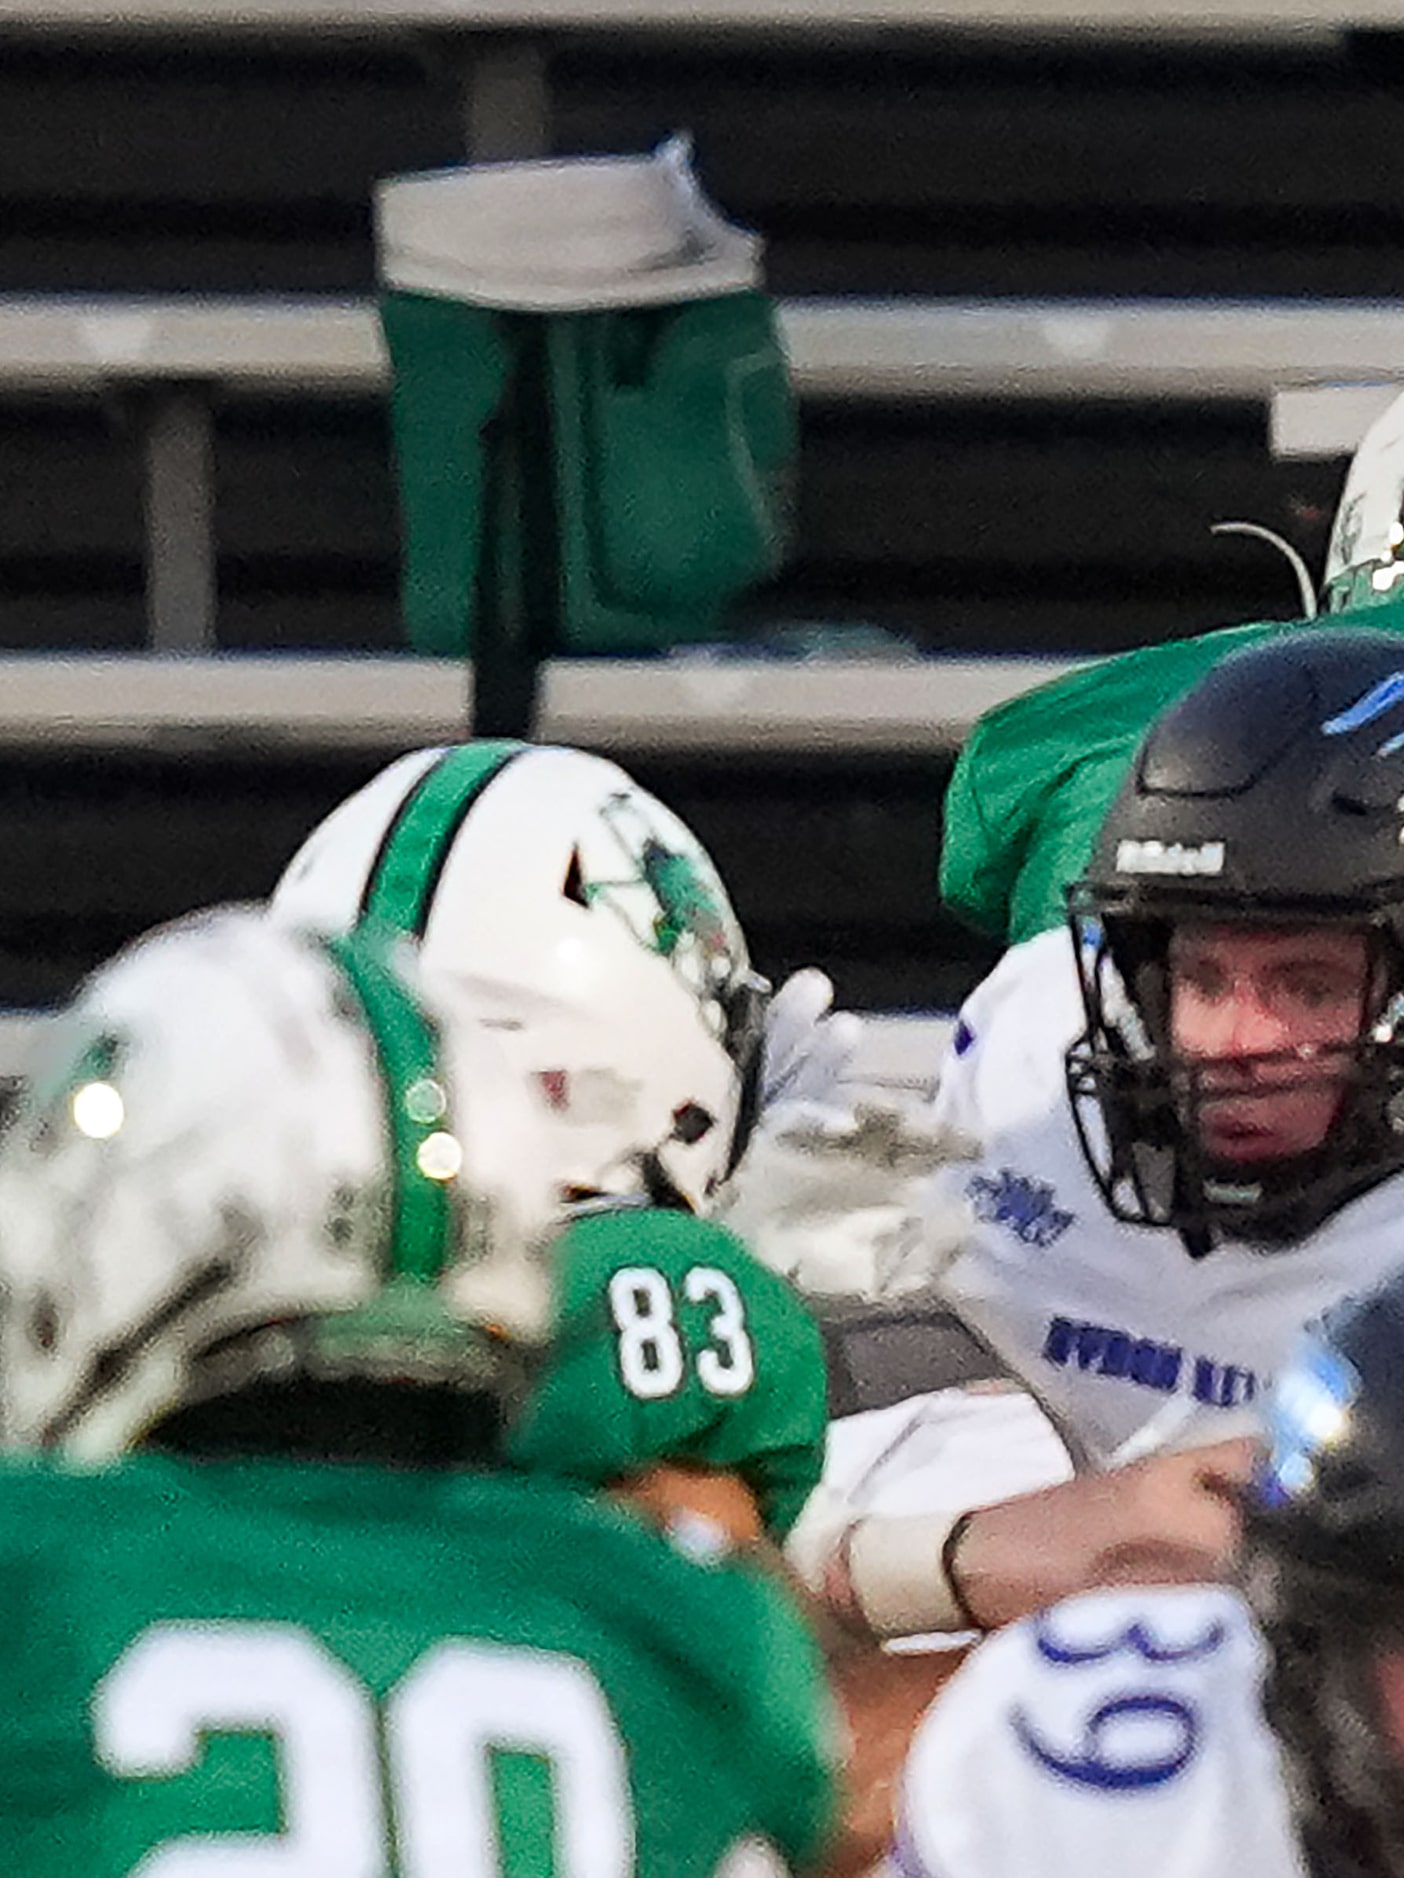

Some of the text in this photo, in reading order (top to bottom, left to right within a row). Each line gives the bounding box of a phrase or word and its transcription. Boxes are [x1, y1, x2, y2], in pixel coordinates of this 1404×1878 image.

[609, 1266, 754, 1399] 83
[92, 1618, 637, 1878] 20
[1008, 1603, 1226, 1797] 39
